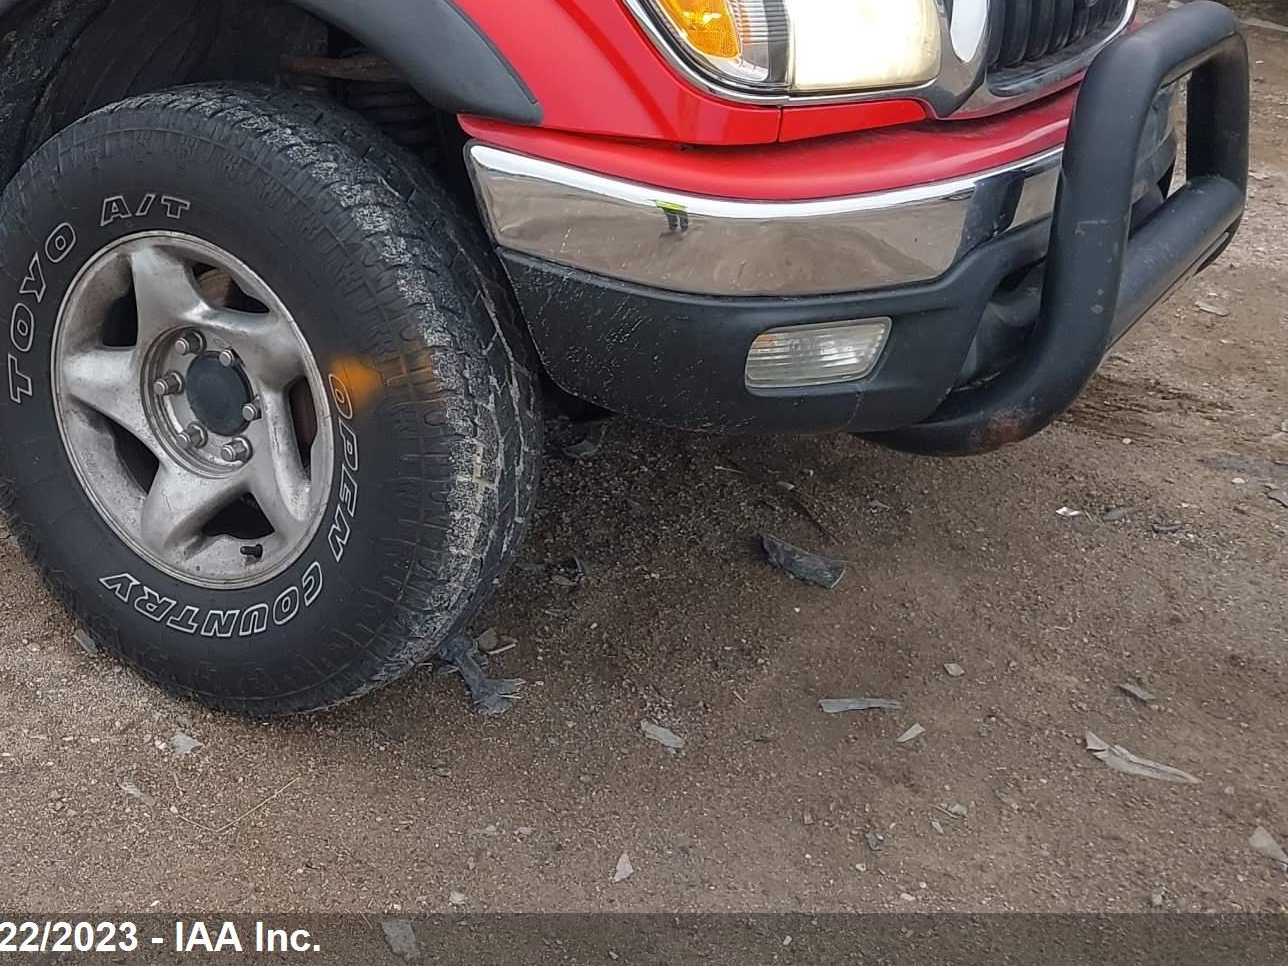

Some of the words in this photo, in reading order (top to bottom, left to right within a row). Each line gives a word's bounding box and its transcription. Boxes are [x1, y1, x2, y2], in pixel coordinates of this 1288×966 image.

[7, 222, 76, 404] TOYO
[100, 192, 190, 226] A/T
[327, 373, 359, 562] OPEN
[99, 561, 324, 637] COUNTRY
